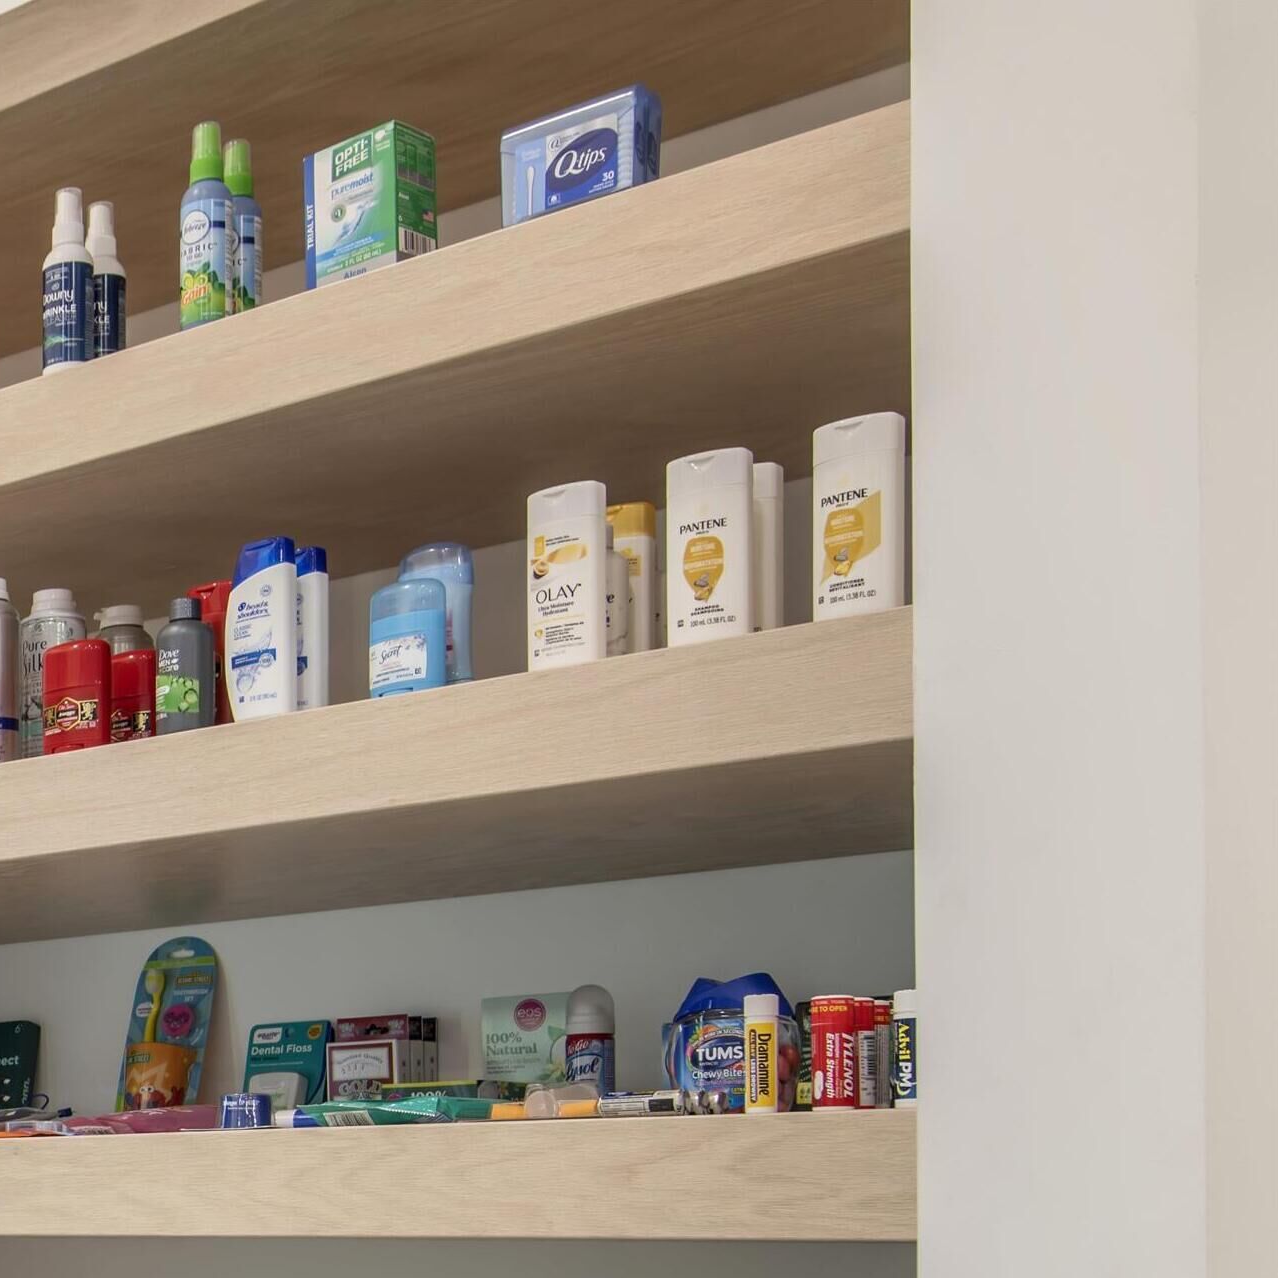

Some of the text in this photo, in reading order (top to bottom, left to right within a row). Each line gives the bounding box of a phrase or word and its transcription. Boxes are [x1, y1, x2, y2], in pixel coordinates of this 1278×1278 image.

[335, 138, 369, 164] OPTI-
[335, 149, 369, 176] FREE
[821, 488, 868, 507] PANTENE
[680, 518, 727, 534] PANTENE
[536, 584, 577, 604] OLAY
[159, 650, 179, 661] Dove
[379, 645, 402, 664] Secret
[517, 1007, 542, 1018] eos
[485, 1032, 523, 1044] 100%
[898, 1023, 909, 1059] Advil
[251, 1044, 312, 1056] Dental Floss
[485, 1043, 537, 1057] Natural
[697, 1045, 743, 1061] TUMS
[758, 1033, 771, 1097] Dramamine
[827, 1033, 836, 1099] Extra Strength
[842, 1032, 854, 1098] TYLENOL
[692, 1070, 722, 1080] Chewy
